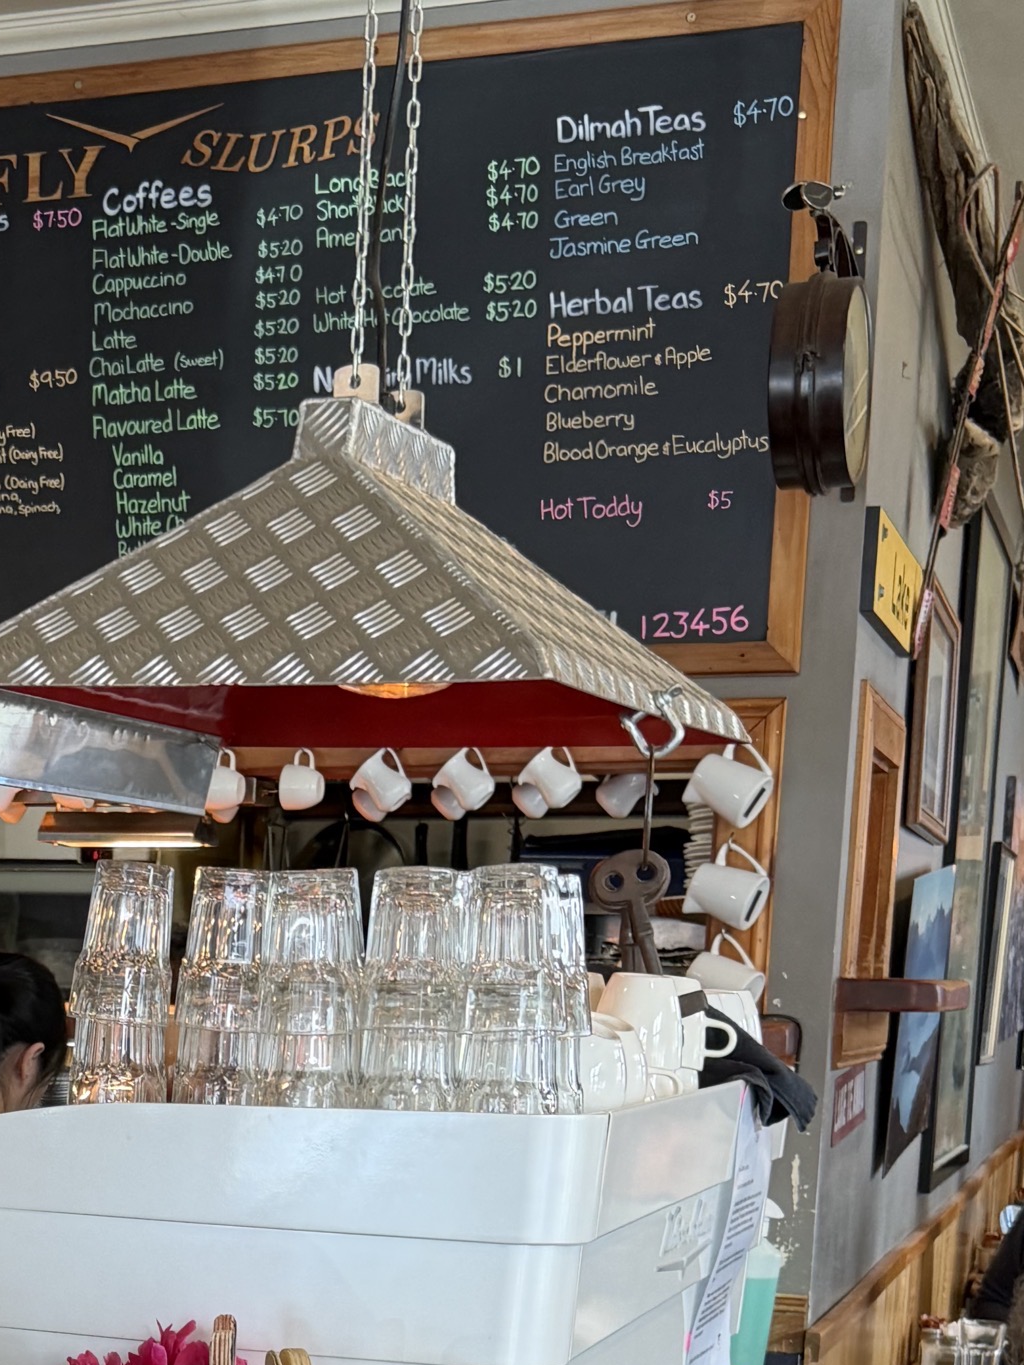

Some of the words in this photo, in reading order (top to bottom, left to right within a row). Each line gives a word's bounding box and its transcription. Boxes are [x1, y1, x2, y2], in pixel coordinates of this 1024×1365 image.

[556, 109, 641, 143] Dilmah
[638, 104, 707, 136] Teas
[180, 112, 382, 174] SLURPS
[554, 150, 617, 176] English
[620, 138, 705, 167] Breakfast
[102, 179, 213, 217] Coffees
[554, 177, 594, 200] Earl
[598, 174, 646, 201] Grey
[92, 214, 125, 241] Flat
[126, 214, 168, 238] White
[554, 210, 618, 229] Green
[92, 247, 125, 271] Flat
[126, 244, 169, 269] White
[549, 236, 631, 259] Jasmine
[634, 229, 699, 250] Green
[92, 272, 187, 299] Cappuccino
[316, 284, 347, 305] Hot
[93, 300, 194, 326] Mochaccino
[549, 286, 634, 319] Herbal
[637, 284, 703, 312] Teas
[92, 330, 138, 352] Latte
[547, 317, 657, 356] Peppermint
[89, 355, 125, 378] Chai
[126, 353, 166, 373] Latte
[416, 357, 473, 386] Milks
[499, 355, 522, 379] $1
[545, 350, 652, 376] Elderflower
[664, 344, 713, 370] Apple
[92, 380, 152, 407] Matcha
[154, 377, 198, 401] Latte
[544, 374, 659, 404] Chamomile
[92, 408, 173, 439] Flavoured
[176, 407, 222, 431] Latte
[546, 411, 635, 432] Blueberry
[112, 442, 164, 467] Vanilla
[543, 441, 593, 464] Blood
[595, 439, 660, 464] Orange
[671, 429, 770, 460] Eucalyptus
[113, 465, 177, 490] Caramel
[116, 489, 191, 515] Hazelnut
[540, 497, 574, 521] Hot
[576, 493, 643, 528] Toddy
[707, 489, 734, 511] $5
[115, 516, 163, 539] White
[640, 604, 749, 640] 123456
